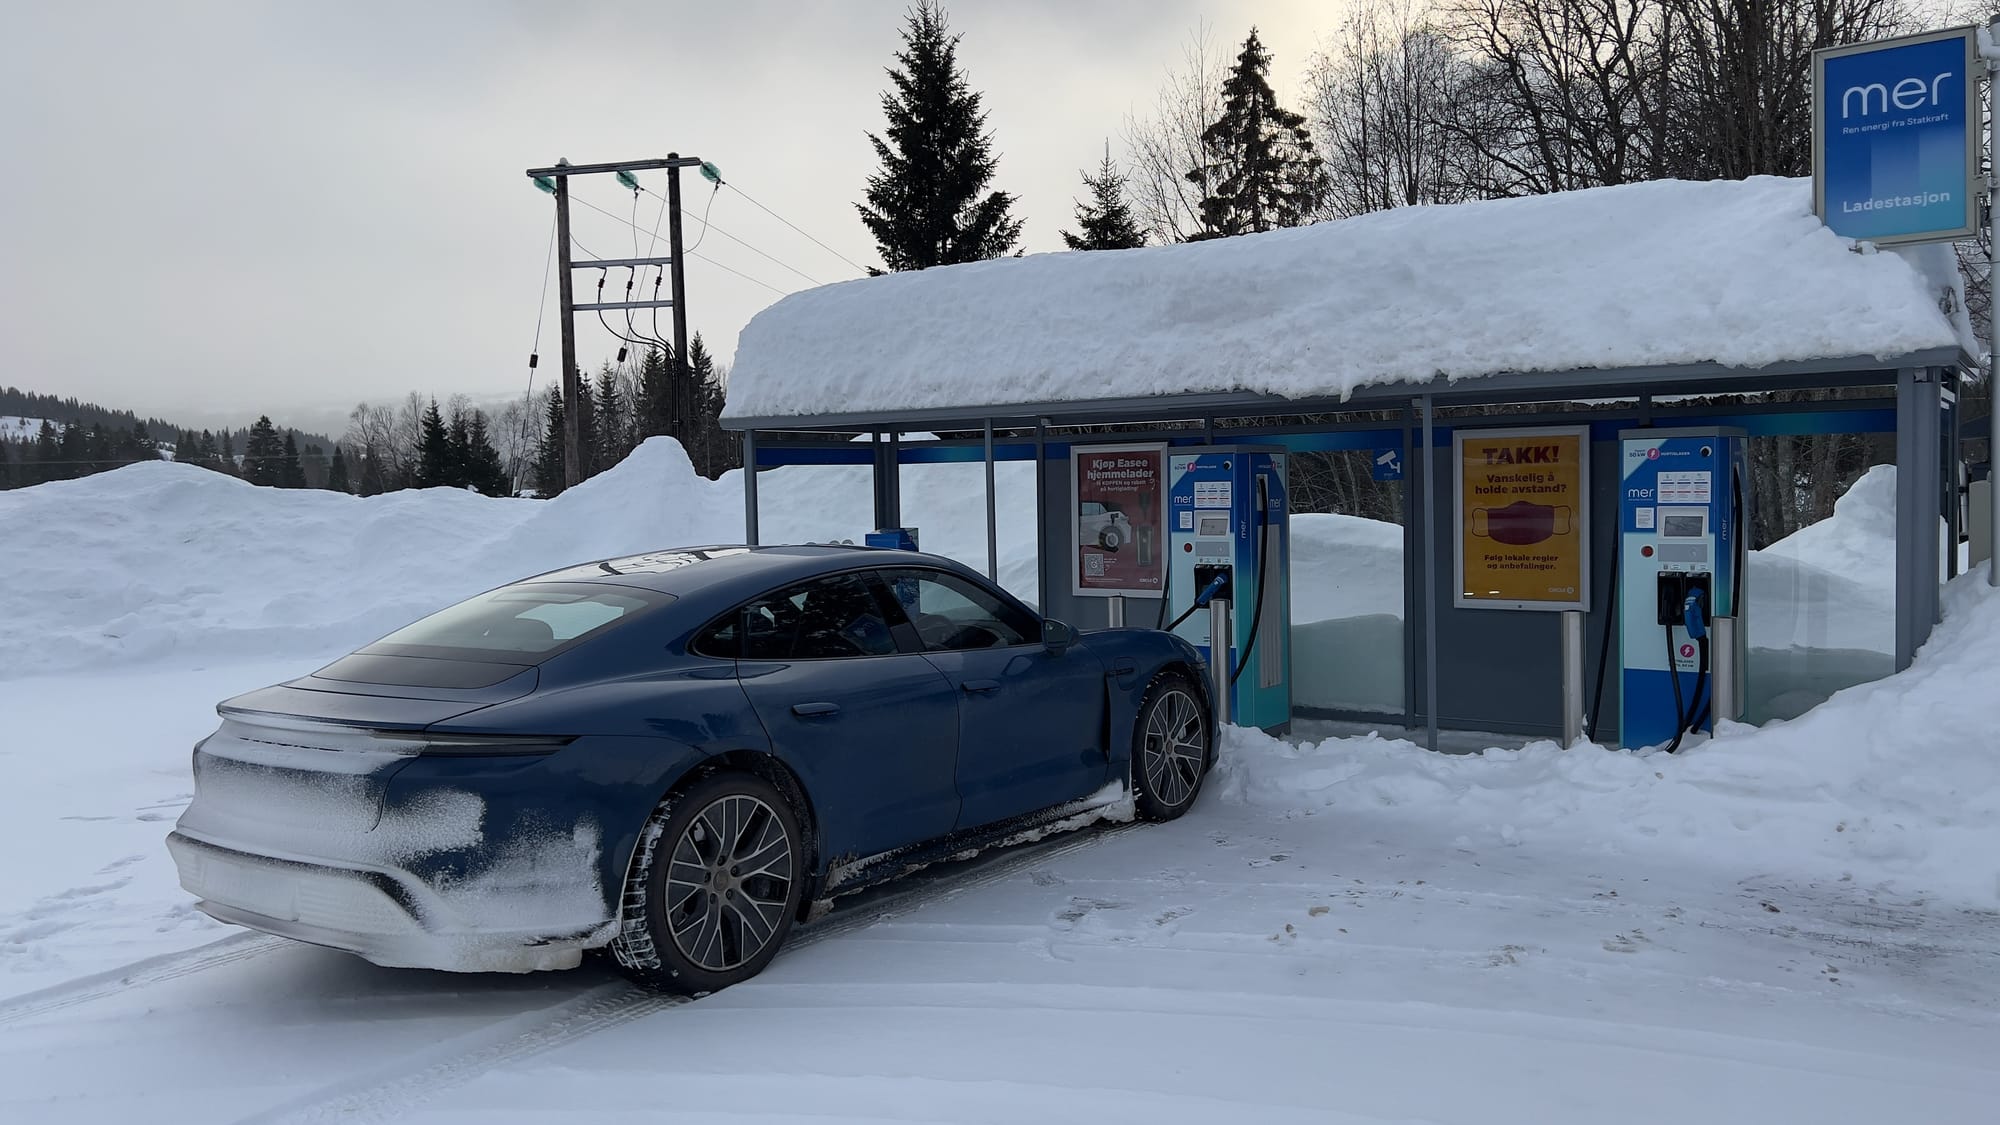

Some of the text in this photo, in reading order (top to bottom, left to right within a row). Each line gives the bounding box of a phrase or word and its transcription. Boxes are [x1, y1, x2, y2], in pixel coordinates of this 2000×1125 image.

[1842, 71, 1952, 119] mer
[1842, 112, 1950, 135] Ren energi fra Statkraft
[1843, 191, 1950, 213] Ladestasjon
[1482, 445, 1560, 465] TAKK!
[1092, 458, 1148, 470] Kjøp Easee
[1087, 469, 1154, 480] hjemmelader
[1486, 471, 1555, 484] Vanskelig å
[1475, 484, 1567, 494] holde avstand?
[1628, 488, 1654, 498] mer
[1174, 495, 1193, 504] mer
[1269, 498, 1282, 508] mer
[1484, 554, 1503, 562] Følg
[1532, 554, 1559, 562] regler
[1499, 562, 1557, 571] anbefalinger.
